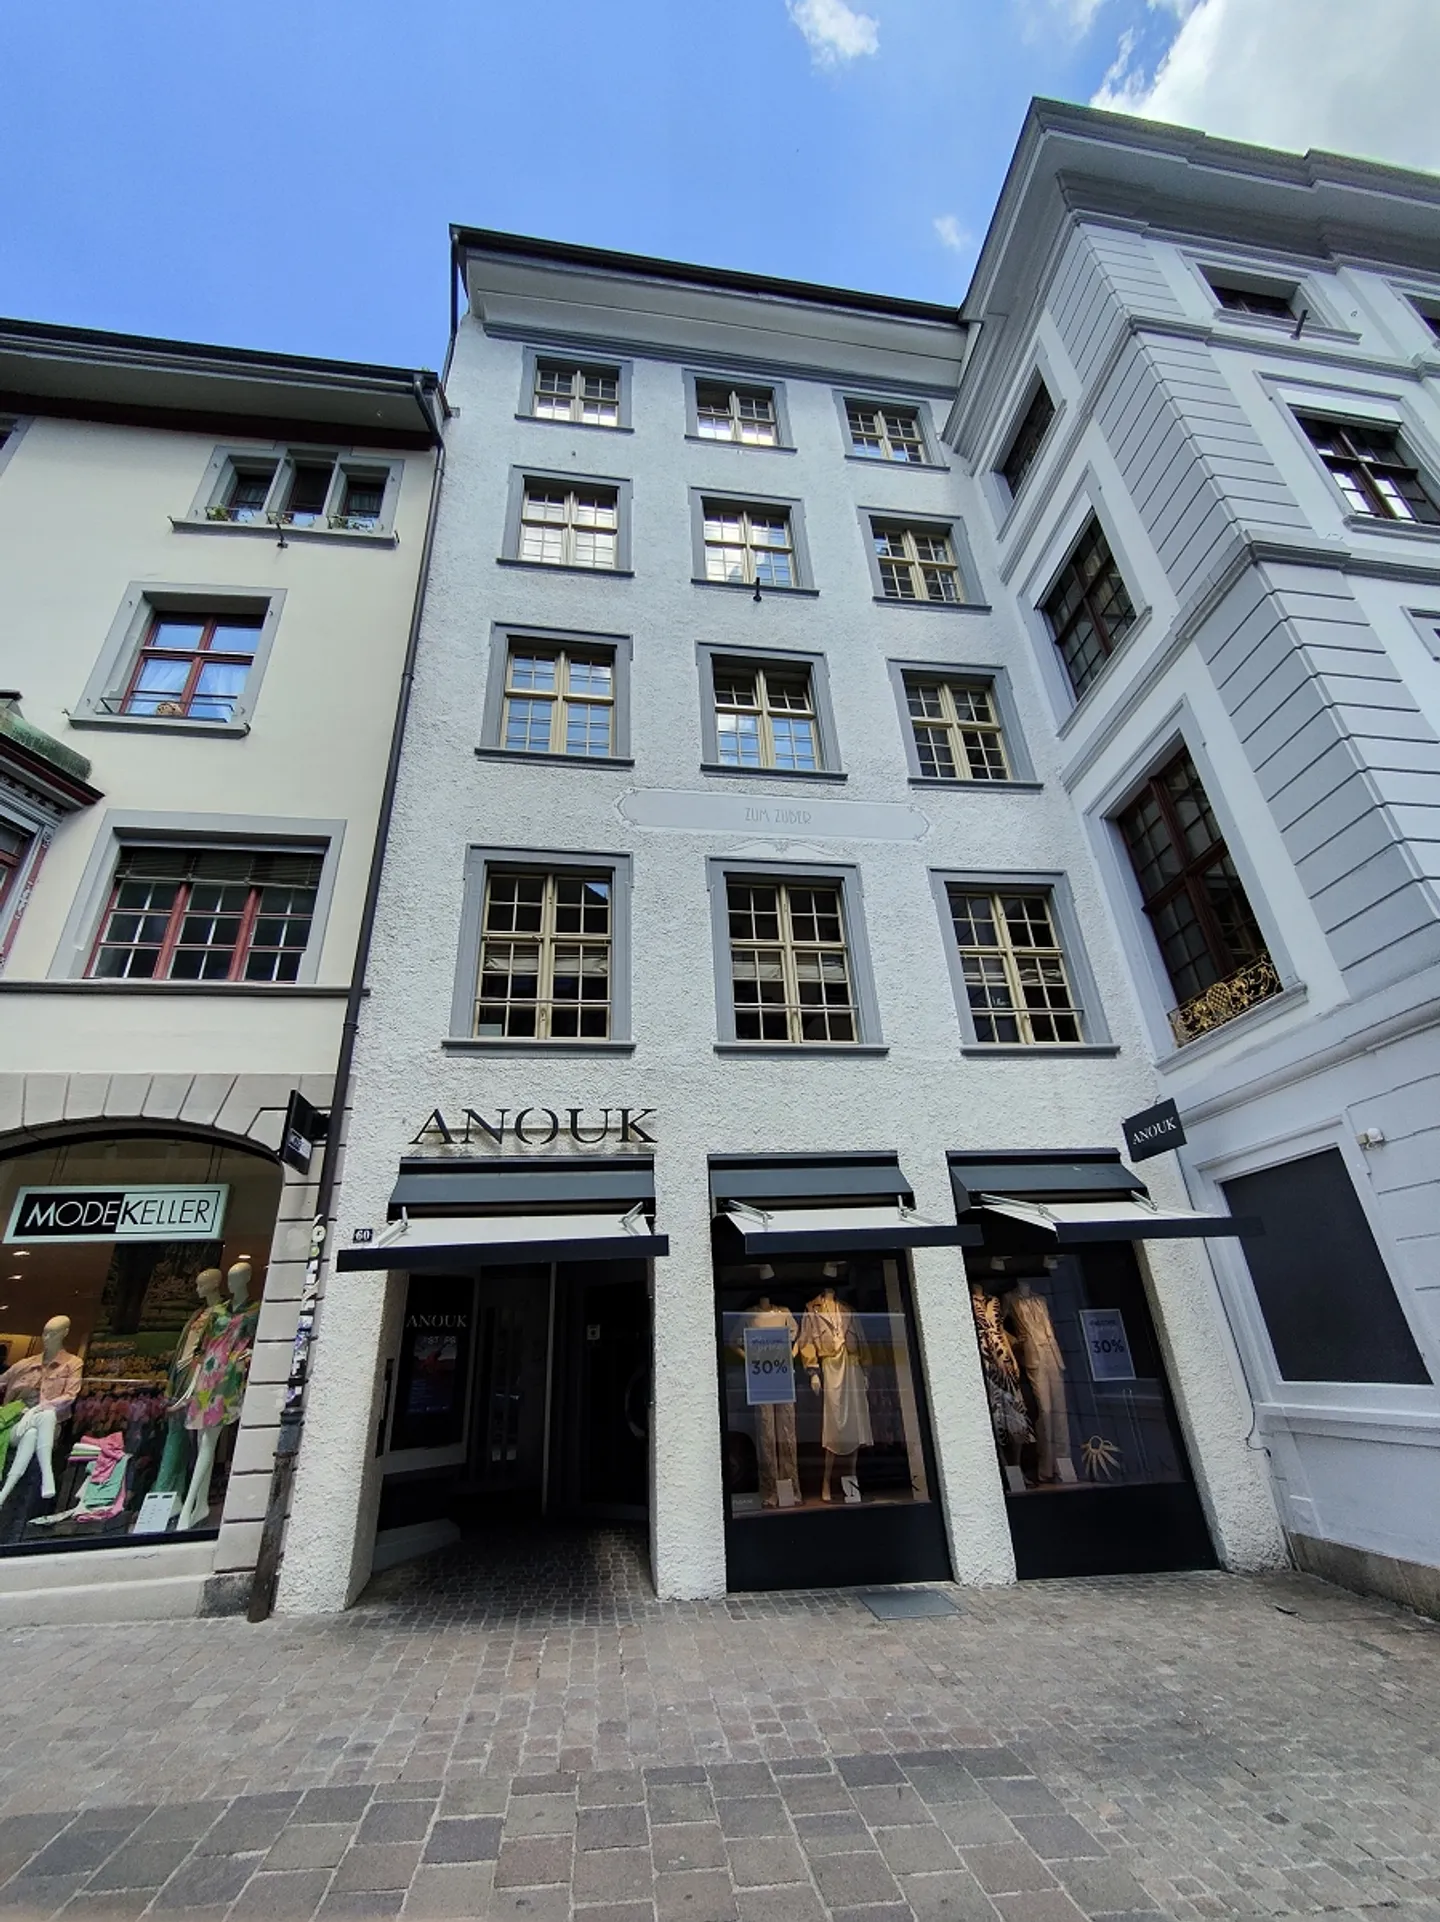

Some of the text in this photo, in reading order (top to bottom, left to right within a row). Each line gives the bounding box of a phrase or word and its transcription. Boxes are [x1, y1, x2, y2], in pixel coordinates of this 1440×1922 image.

[744, 807, 769, 822] ZUM
[407, 1107, 659, 1145] ANOUK
[1132, 1116, 1177, 1145] ANOUK
[24, 1199, 211, 1228] MODEKELLER
[355, 1230, 370, 1241] 60
[405, 1314, 468, 1328] ANOUK
[1091, 1339, 1125, 1354] 30%
[751, 1359, 788, 1376] 30%
